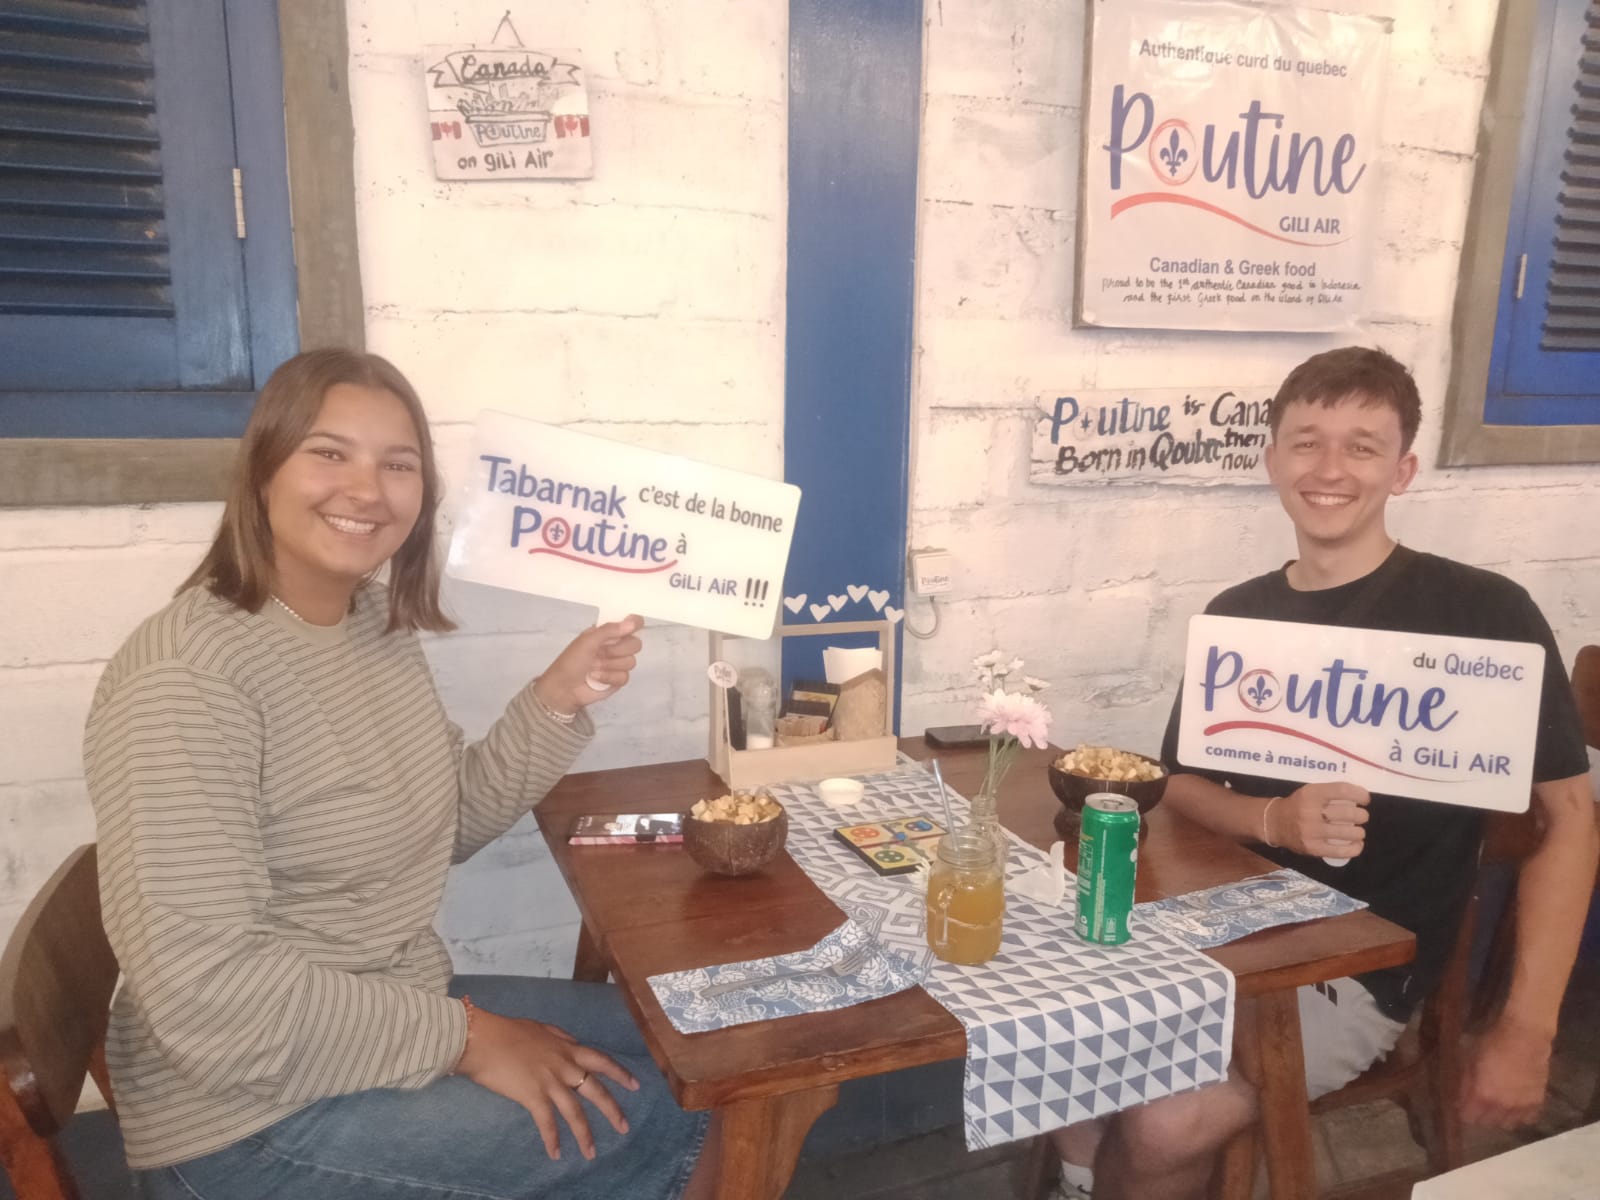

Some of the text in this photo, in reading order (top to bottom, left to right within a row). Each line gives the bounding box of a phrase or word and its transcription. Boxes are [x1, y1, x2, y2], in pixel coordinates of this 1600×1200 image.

[461, 55, 549, 82] Canada
[1236, 53, 1269, 69] curd
[1273, 56, 1292, 72] du
[1296, 59, 1348, 78] quebec
[1102, 84, 1367, 200] Poutine
[457, 155, 477, 170] on
[525, 148, 553, 169] Air
[1279, 216, 1341, 235] GILI AIR
[1150, 257, 1316, 277] Canadian & Greek food
[1136, 277, 1144, 288] to
[1146, 278, 1156, 288] be
[1160, 278, 1174, 289] the
[1235, 279, 1276, 289] Canadian
[1321, 279, 1360, 290] Indonesia
[1150, 291, 1162, 303] the
[1251, 294, 1260, 302] on
[1264, 292, 1275, 302] the
[1278, 293, 1303, 303] island
[1210, 391, 1276, 427] Cana
[1055, 446, 1122, 475] Born
[1126, 447, 1146, 471] in
[1222, 453, 1259, 470] now
[480, 454, 783, 533] Tabarnak c'est de la bonne
[510, 506, 688, 563] Poutine à
[744, 577, 770, 608] !!!
[1412, 652, 1524, 681] du Québec
[1200, 646, 1459, 732] Poutine
[1205, 745, 1261, 762] comme
[1265, 752, 1273, 763] à
[1278, 754, 1337, 773] maison
[1389, 740, 1402, 763] à
